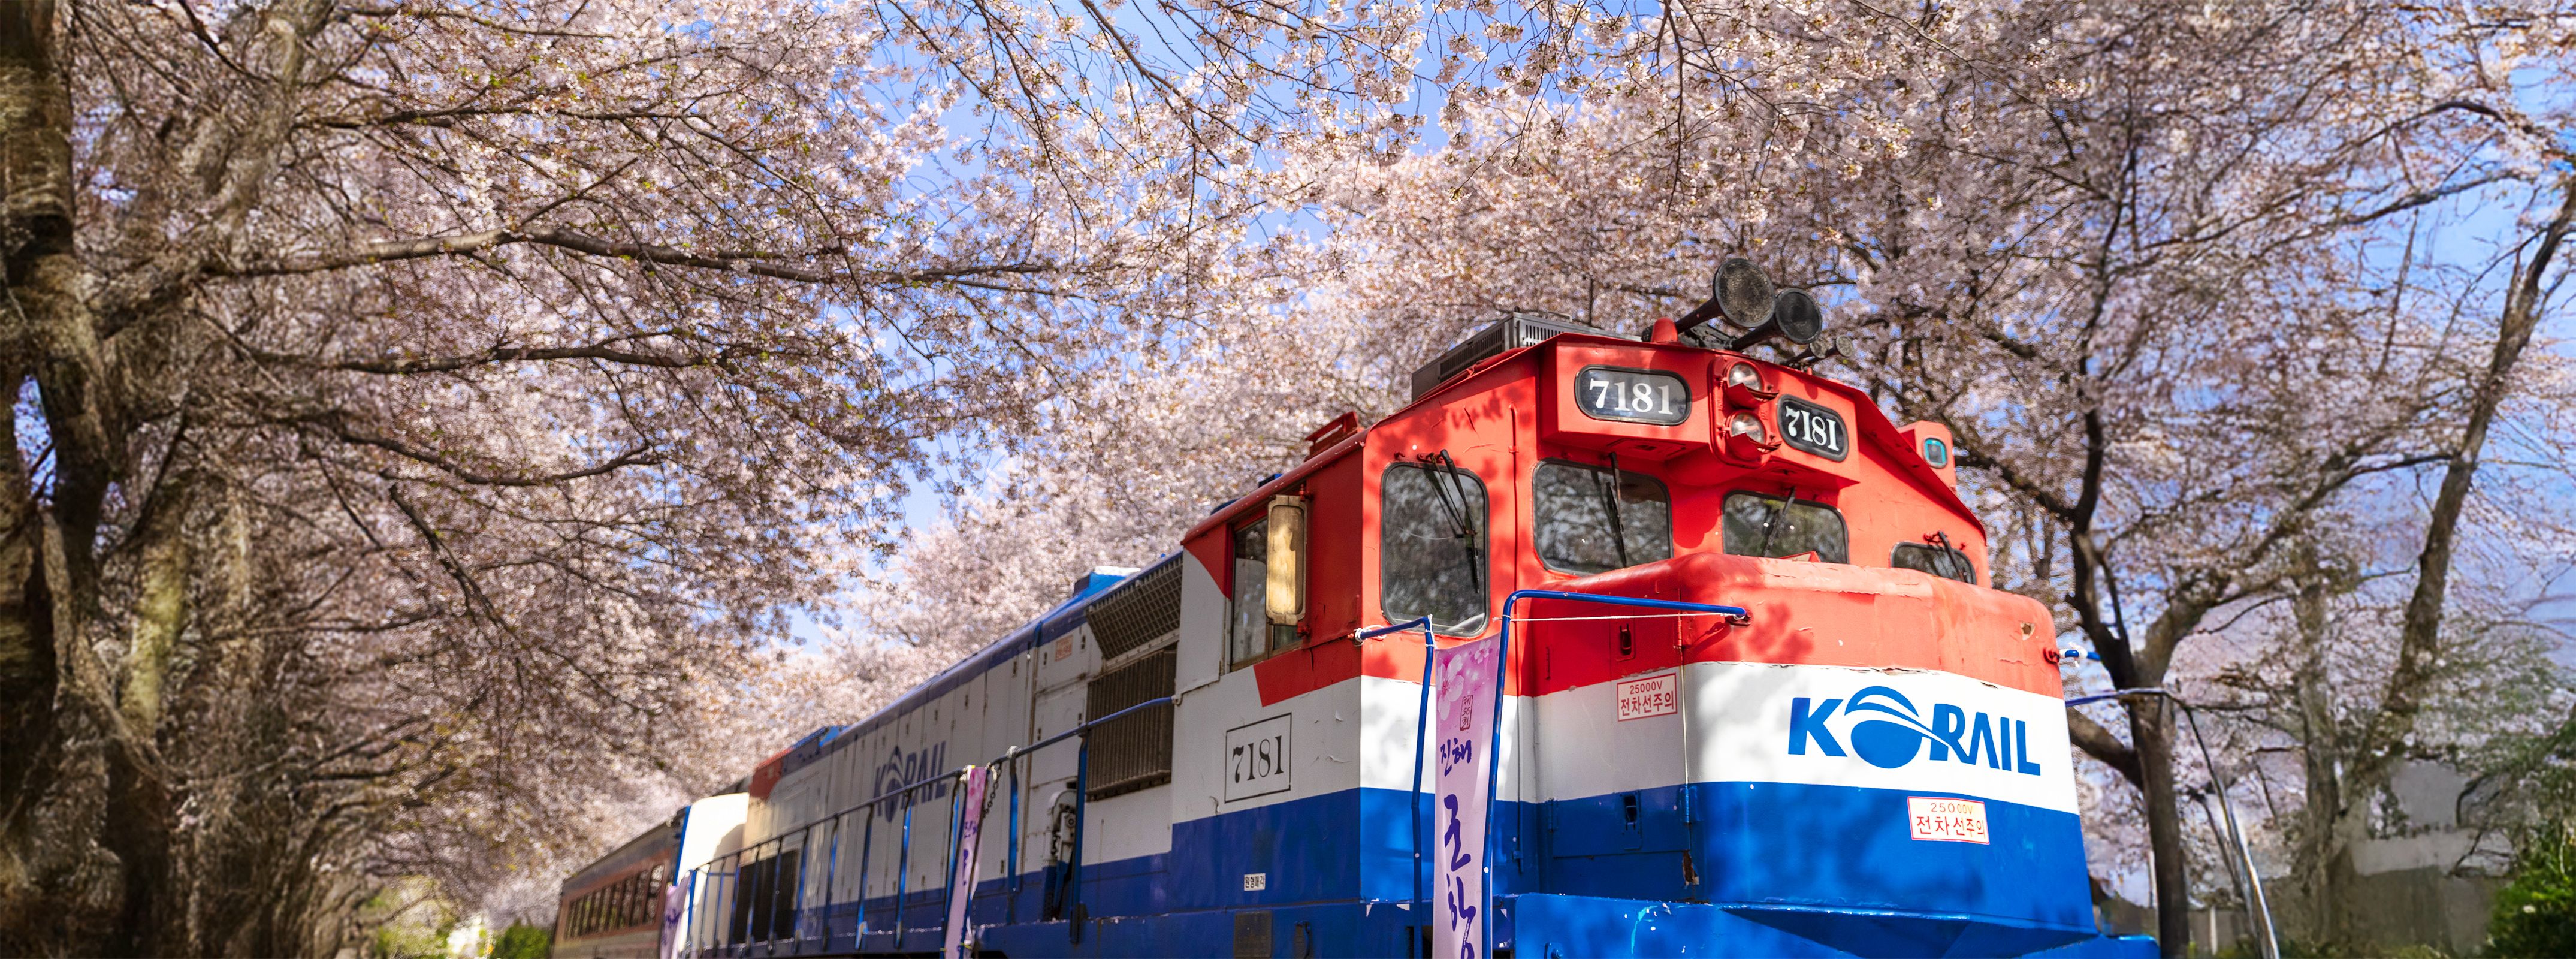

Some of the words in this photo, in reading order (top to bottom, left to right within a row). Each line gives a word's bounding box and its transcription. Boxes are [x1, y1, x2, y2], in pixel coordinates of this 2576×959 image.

[1589, 378, 1674, 415] 7181
[1785, 405, 1840, 451] 7181
[1621, 690, 1674, 716] 전차선주의
[1630, 680, 1663, 695] 25000V
[1787, 686, 2041, 776] KORAIL
[1232, 735, 1284, 783] 7181
[1440, 737, 1472, 777] 진해
[1931, 803, 1973, 814] 25000V
[1916, 816, 1985, 839] 전차선주의
